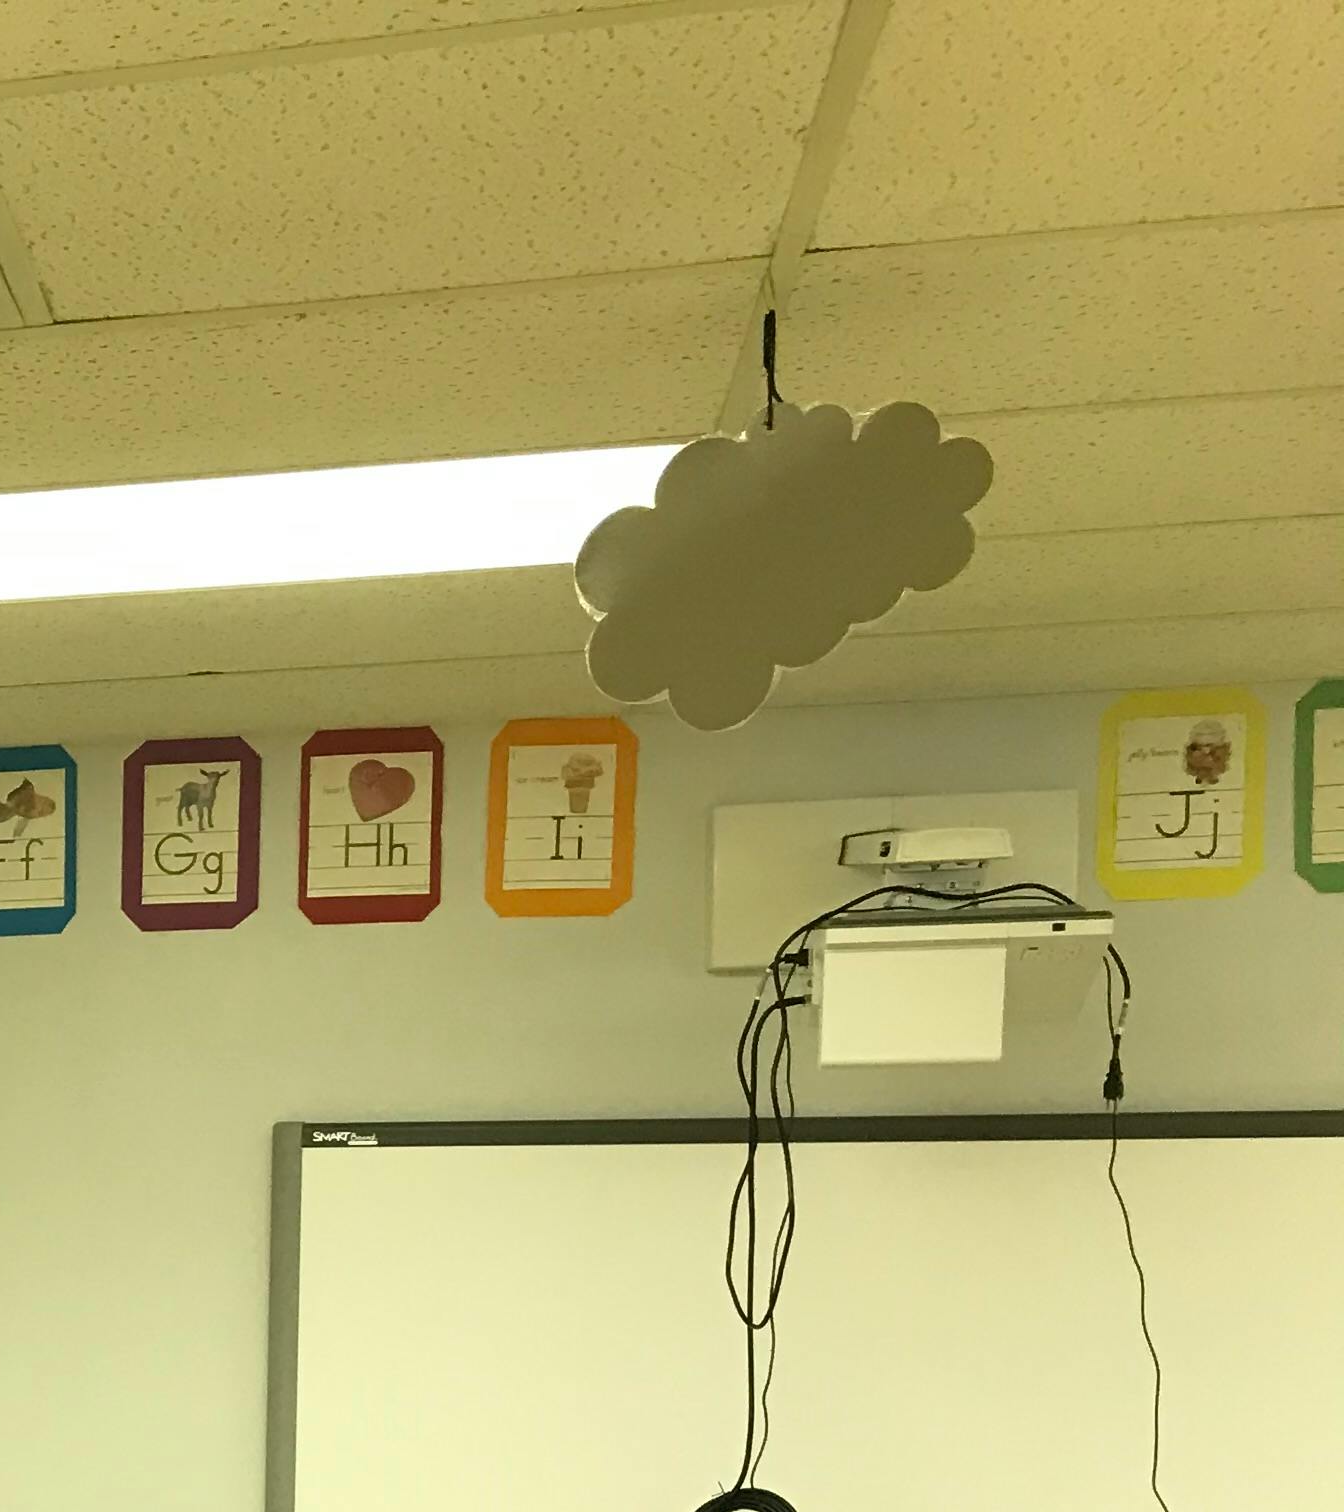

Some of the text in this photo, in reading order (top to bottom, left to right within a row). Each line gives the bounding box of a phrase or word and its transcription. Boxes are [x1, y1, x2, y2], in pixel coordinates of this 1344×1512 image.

[344, 822, 408, 867] Hh
[549, 816, 584, 860] Ii
[1155, 789, 1220, 860] Jj
[155, 832, 223, 894] Gg
[312, 1131, 351, 1142] SMART
